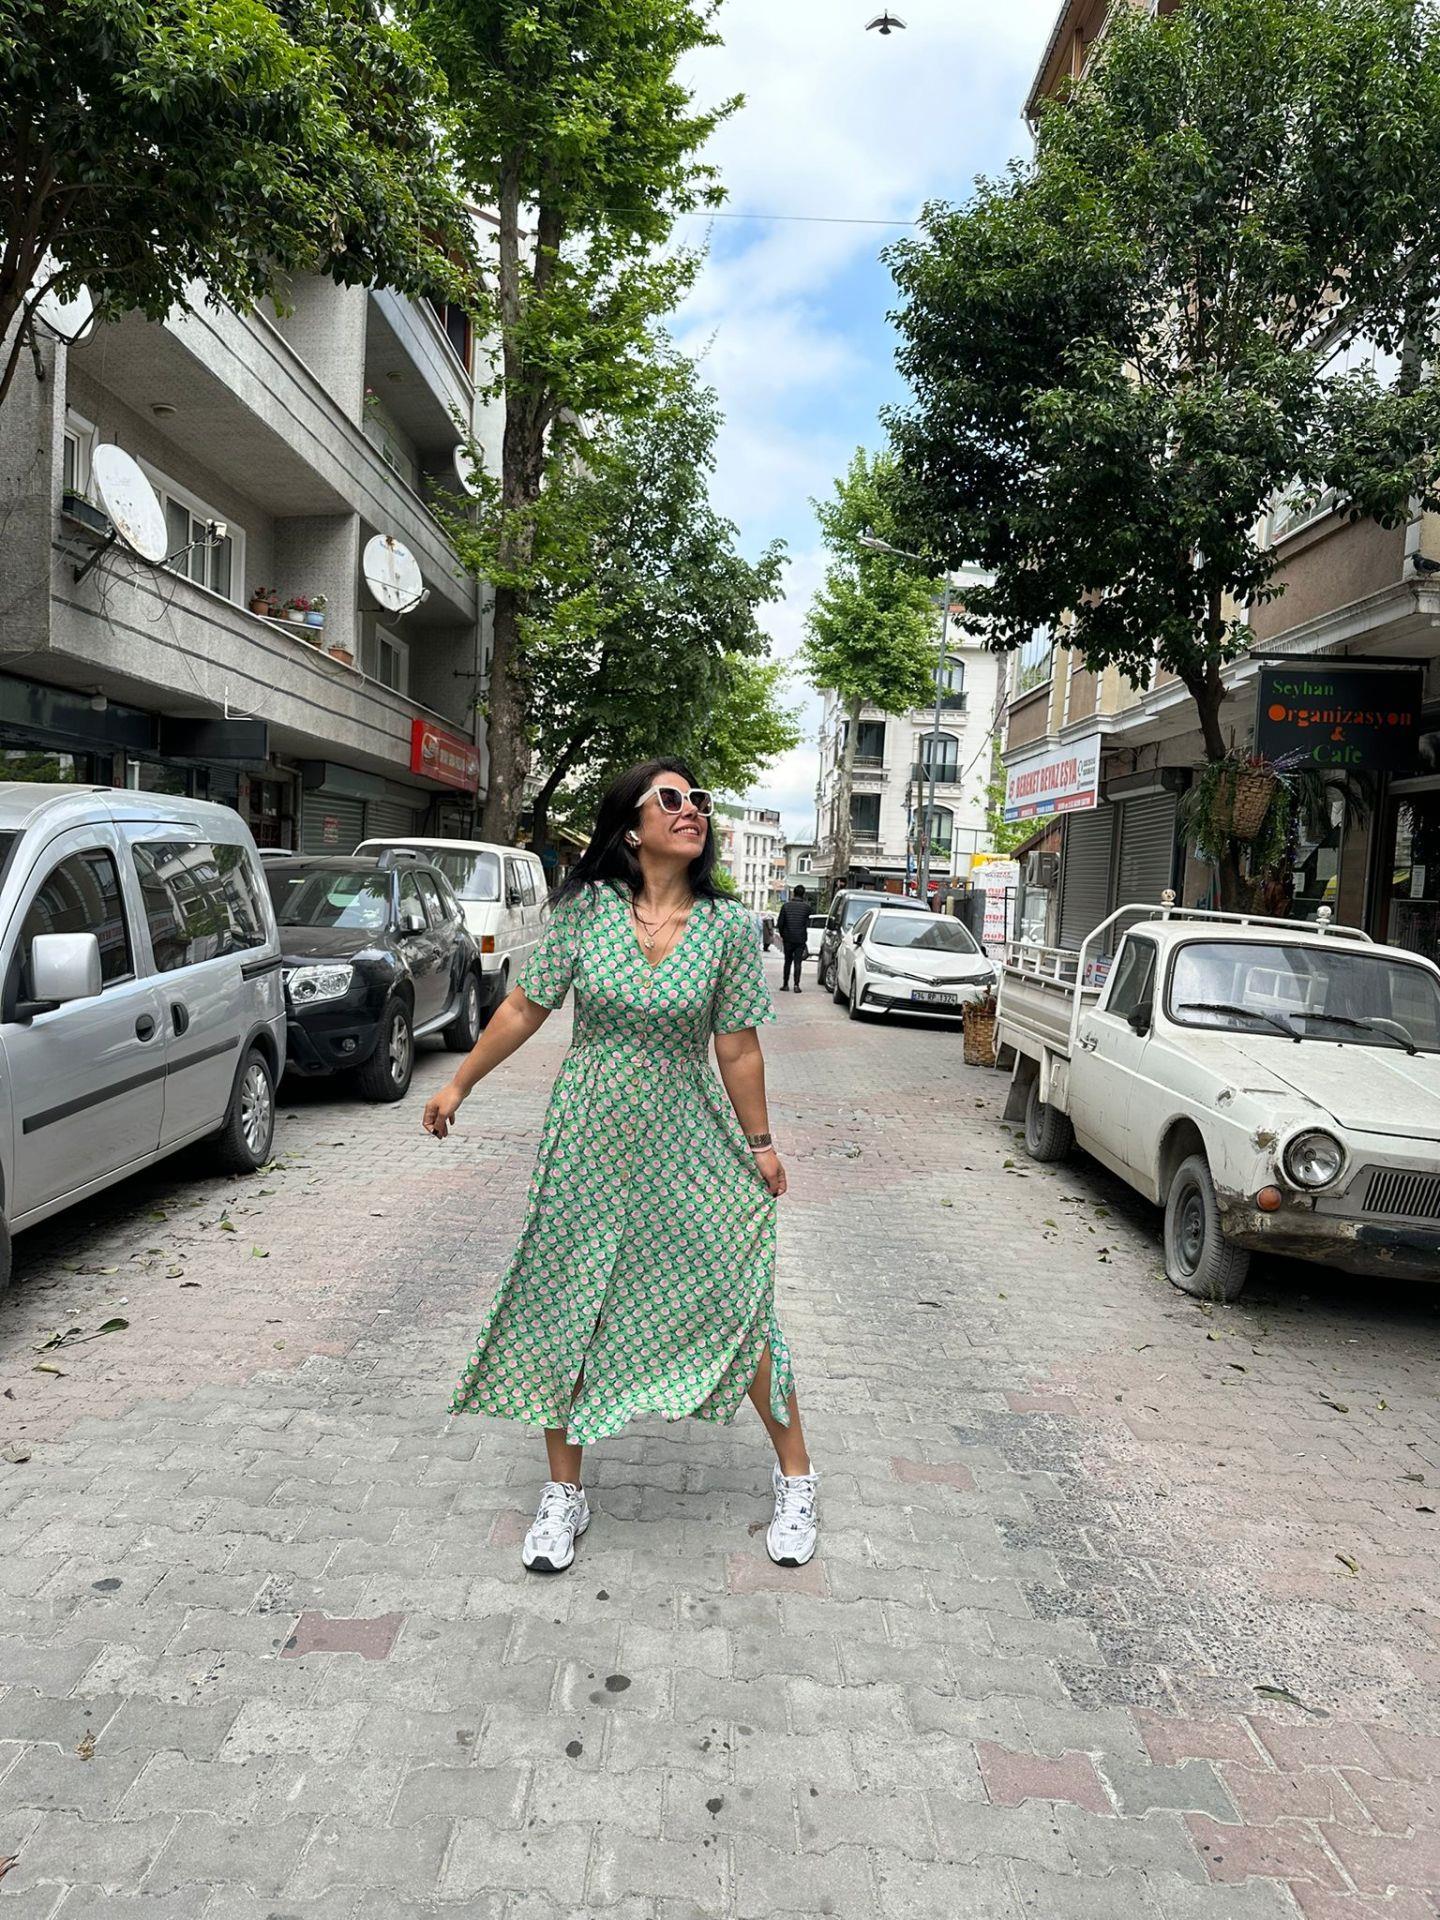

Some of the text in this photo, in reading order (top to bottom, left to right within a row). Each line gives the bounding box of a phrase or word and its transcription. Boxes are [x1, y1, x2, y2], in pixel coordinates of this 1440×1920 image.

[1272, 680, 1334, 698] Seyhan
[1268, 704, 1412, 729] Organizasyon
[1330, 727, 1345, 741] &
[1312, 744, 1362, 763] Cafe
[1016, 770, 1040, 798] BEREKET
[1040, 763, 1059, 792] BEYAZ
[1060, 758, 1077, 791] EŞYA
